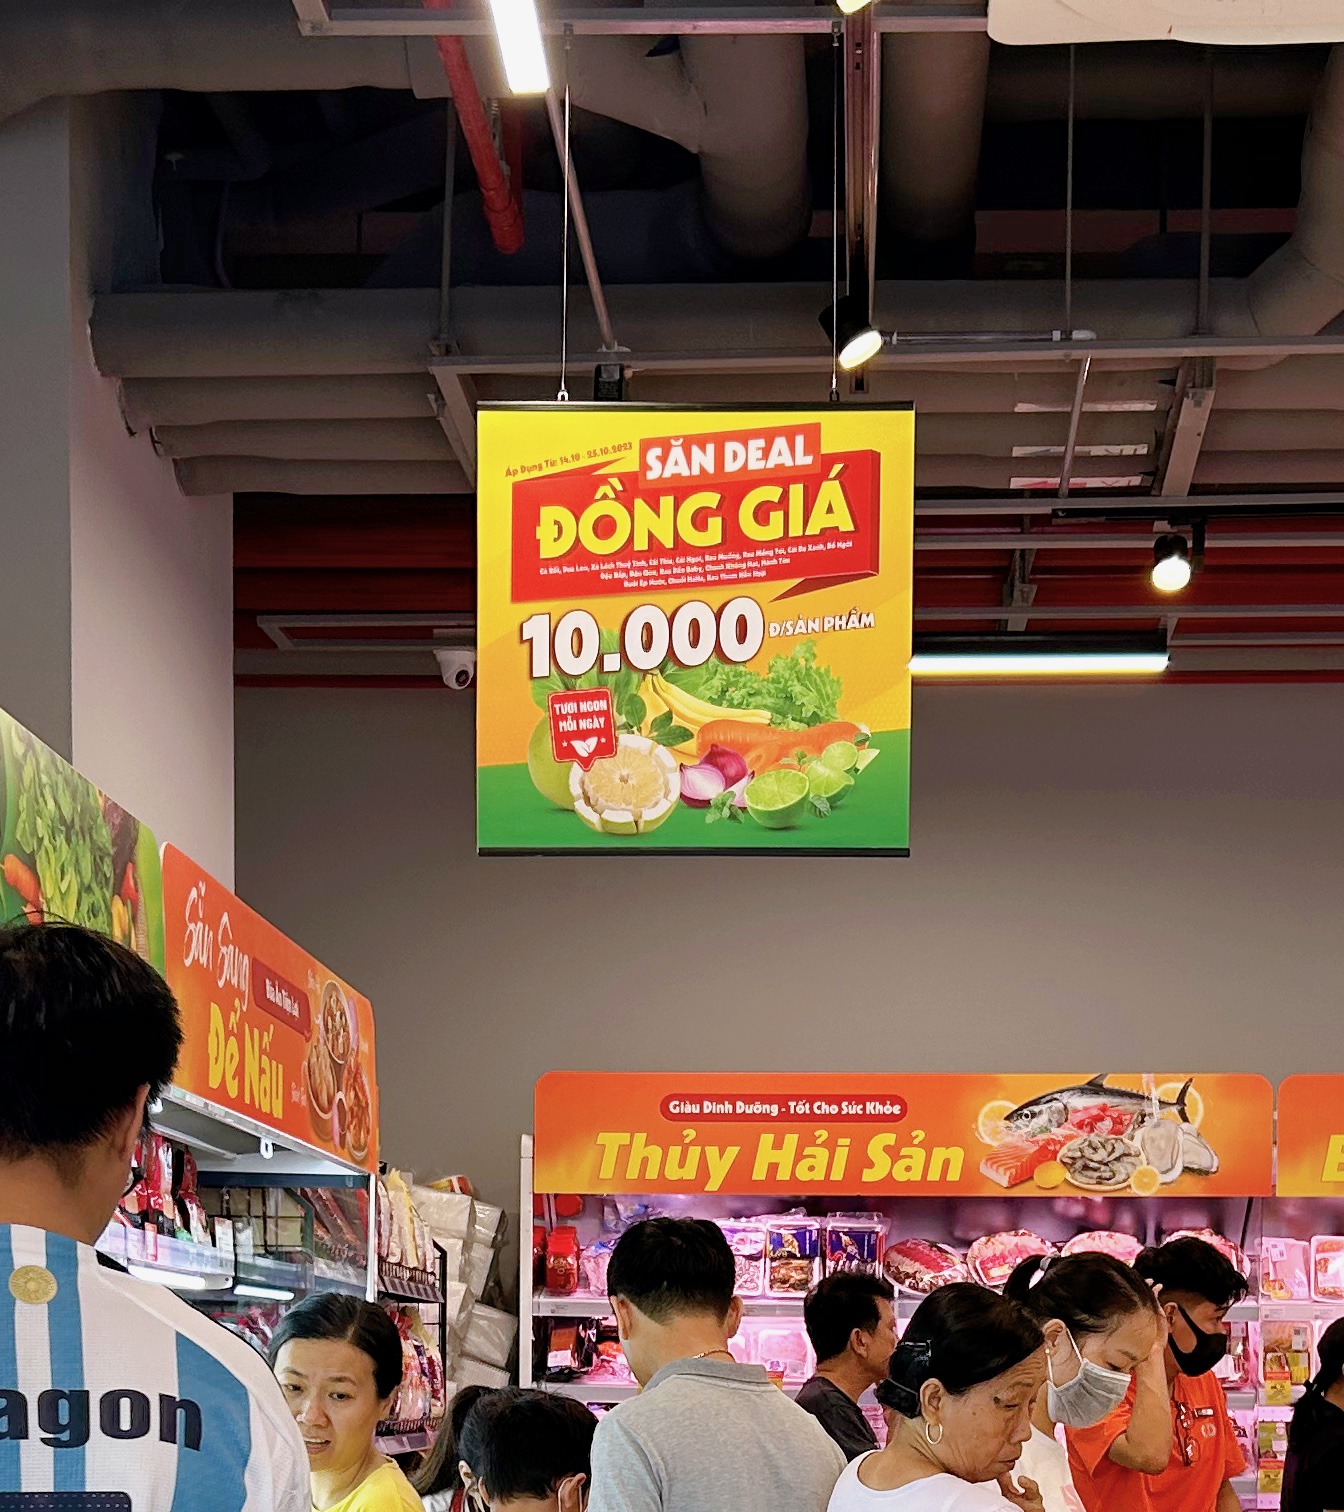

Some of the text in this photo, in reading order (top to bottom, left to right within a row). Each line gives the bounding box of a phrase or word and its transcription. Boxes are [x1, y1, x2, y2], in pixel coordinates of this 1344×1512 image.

[521, 463, 543, 474] Dụng
[645, 433, 813, 480] SĂN DEAL
[536, 477, 724, 560] ĐỒNG
[738, 463, 855, 542] GIÁ
[519, 595, 766, 680] 10.000
[769, 606, 875, 638] Đ/SẢN PHẨM
[559, 714, 605, 732] MỖI NGÀY
[579, 699, 607, 713] NGON
[208, 997, 284, 1120] Để Nấu
[668, 1100, 700, 1114] Giàu
[703, 1101, 733, 1114] Dinh
[735, 1101, 778, 1117] Dưỡng
[788, 1099, 810, 1114] Tốt
[813, 1101, 838, 1114] Cho
[841, 1100, 863, 1114] Sức
[865, 1100, 901, 1114] Khỏe
[595, 1128, 965, 1191] Thủy Hải Sản
